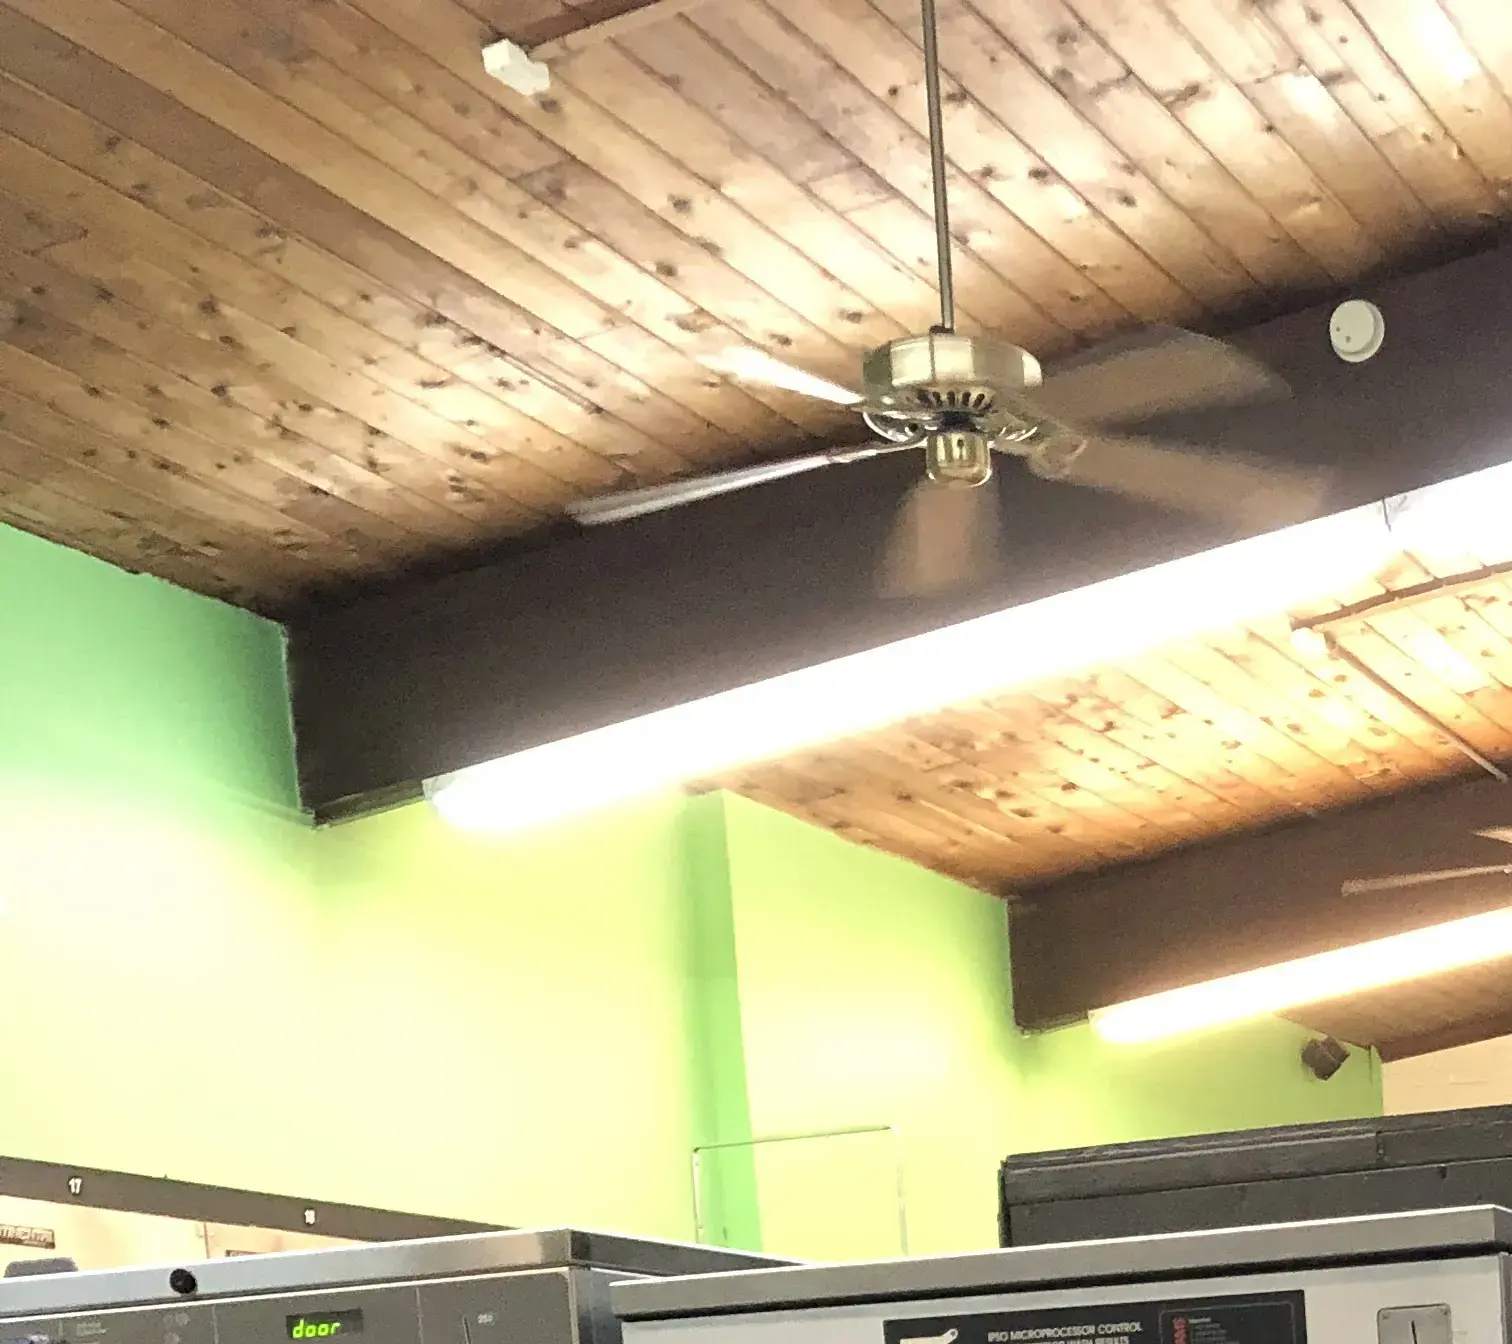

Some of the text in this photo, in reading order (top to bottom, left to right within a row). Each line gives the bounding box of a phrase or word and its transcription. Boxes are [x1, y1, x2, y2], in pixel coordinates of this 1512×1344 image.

[69, 1178, 82, 1194] 17
[292, 1318, 341, 1339] door
[1010, 1324, 1096, 1341] MICROPROCESSOR
[1097, 1321, 1143, 1335] CONTROL
